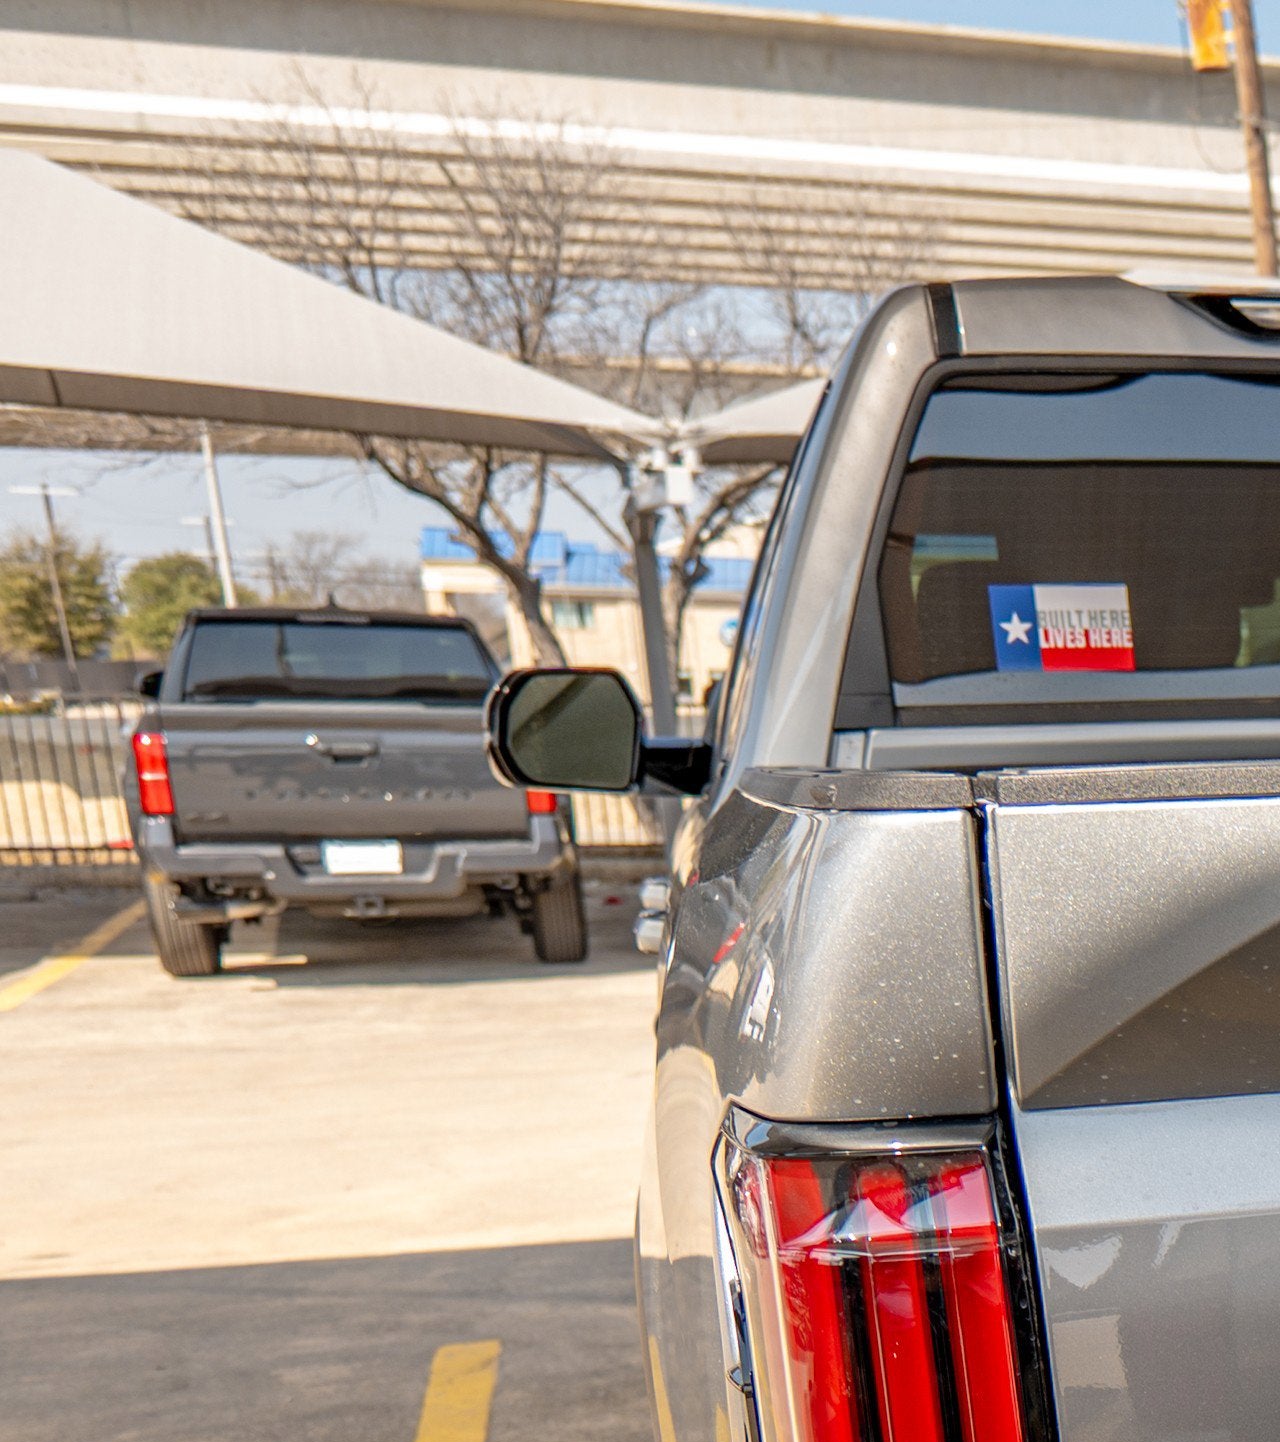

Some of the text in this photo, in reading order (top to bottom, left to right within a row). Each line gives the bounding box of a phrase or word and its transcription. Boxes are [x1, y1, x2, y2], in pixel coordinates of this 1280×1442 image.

[1038, 609, 1131, 629] BUILT HERE
[1039, 628, 1134, 648] LIVES HERE
